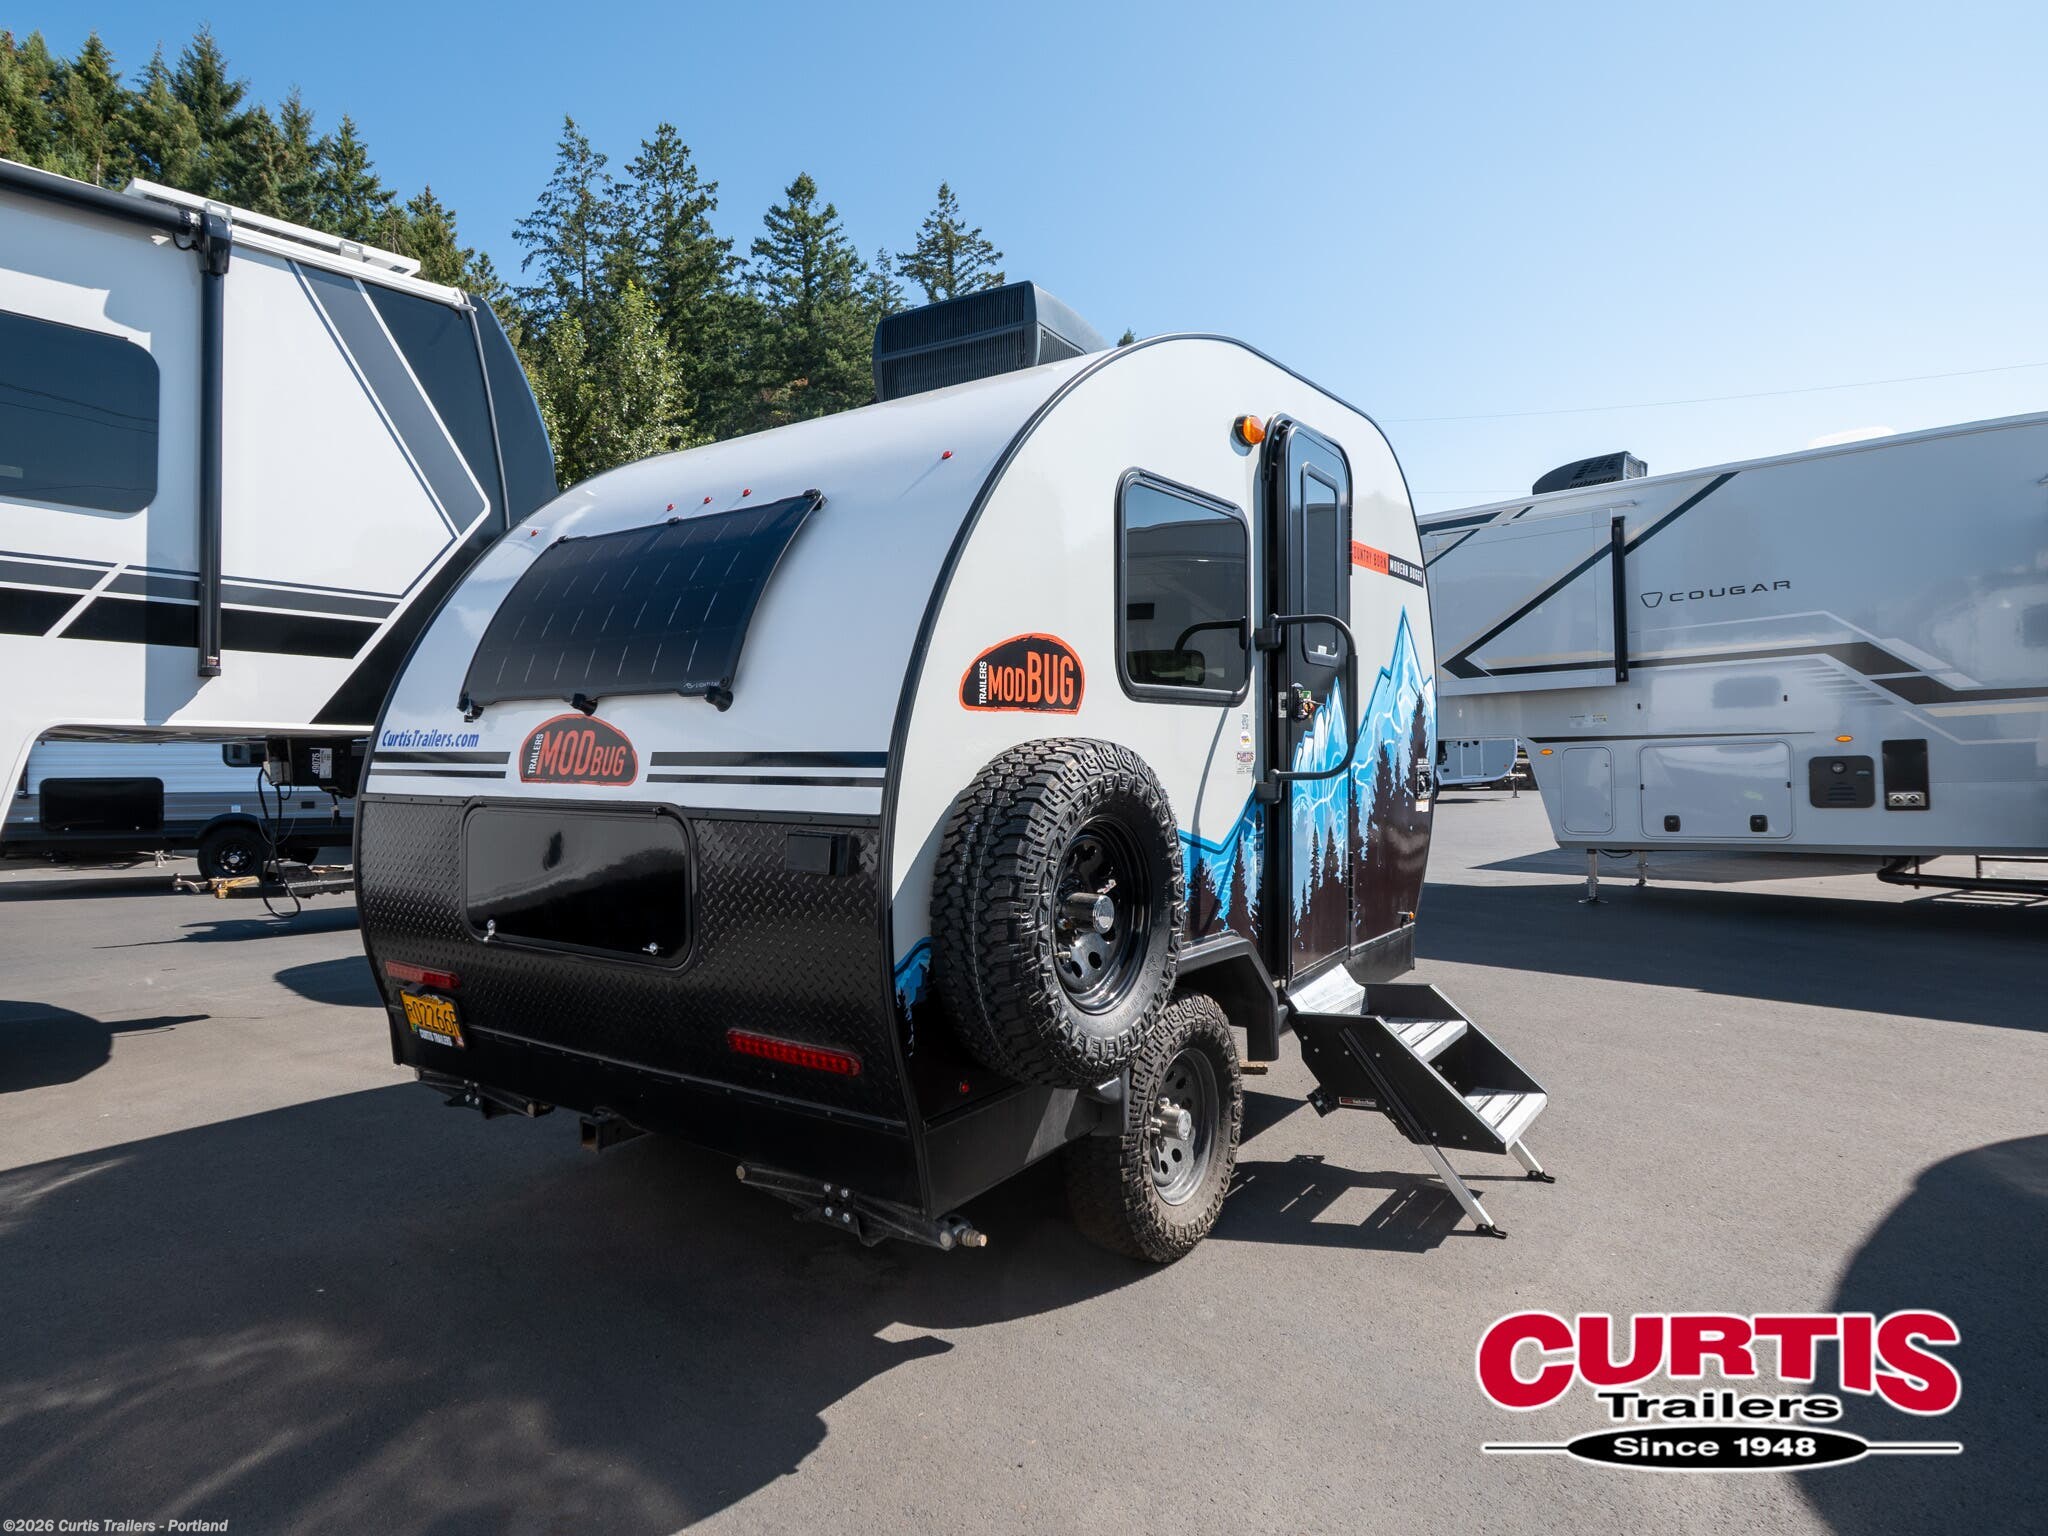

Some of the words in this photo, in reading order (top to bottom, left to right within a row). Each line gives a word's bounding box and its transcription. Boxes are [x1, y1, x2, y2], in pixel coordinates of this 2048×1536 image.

[1669, 580, 1791, 602] COUGAR
[979, 660, 988, 705] TRAILERS
[987, 650, 1074, 705] MODBUG
[381, 728, 479, 748] CurtisTrailers.com
[527, 732, 545, 775] TRAILERS
[536, 729, 627, 777] MODBUG
